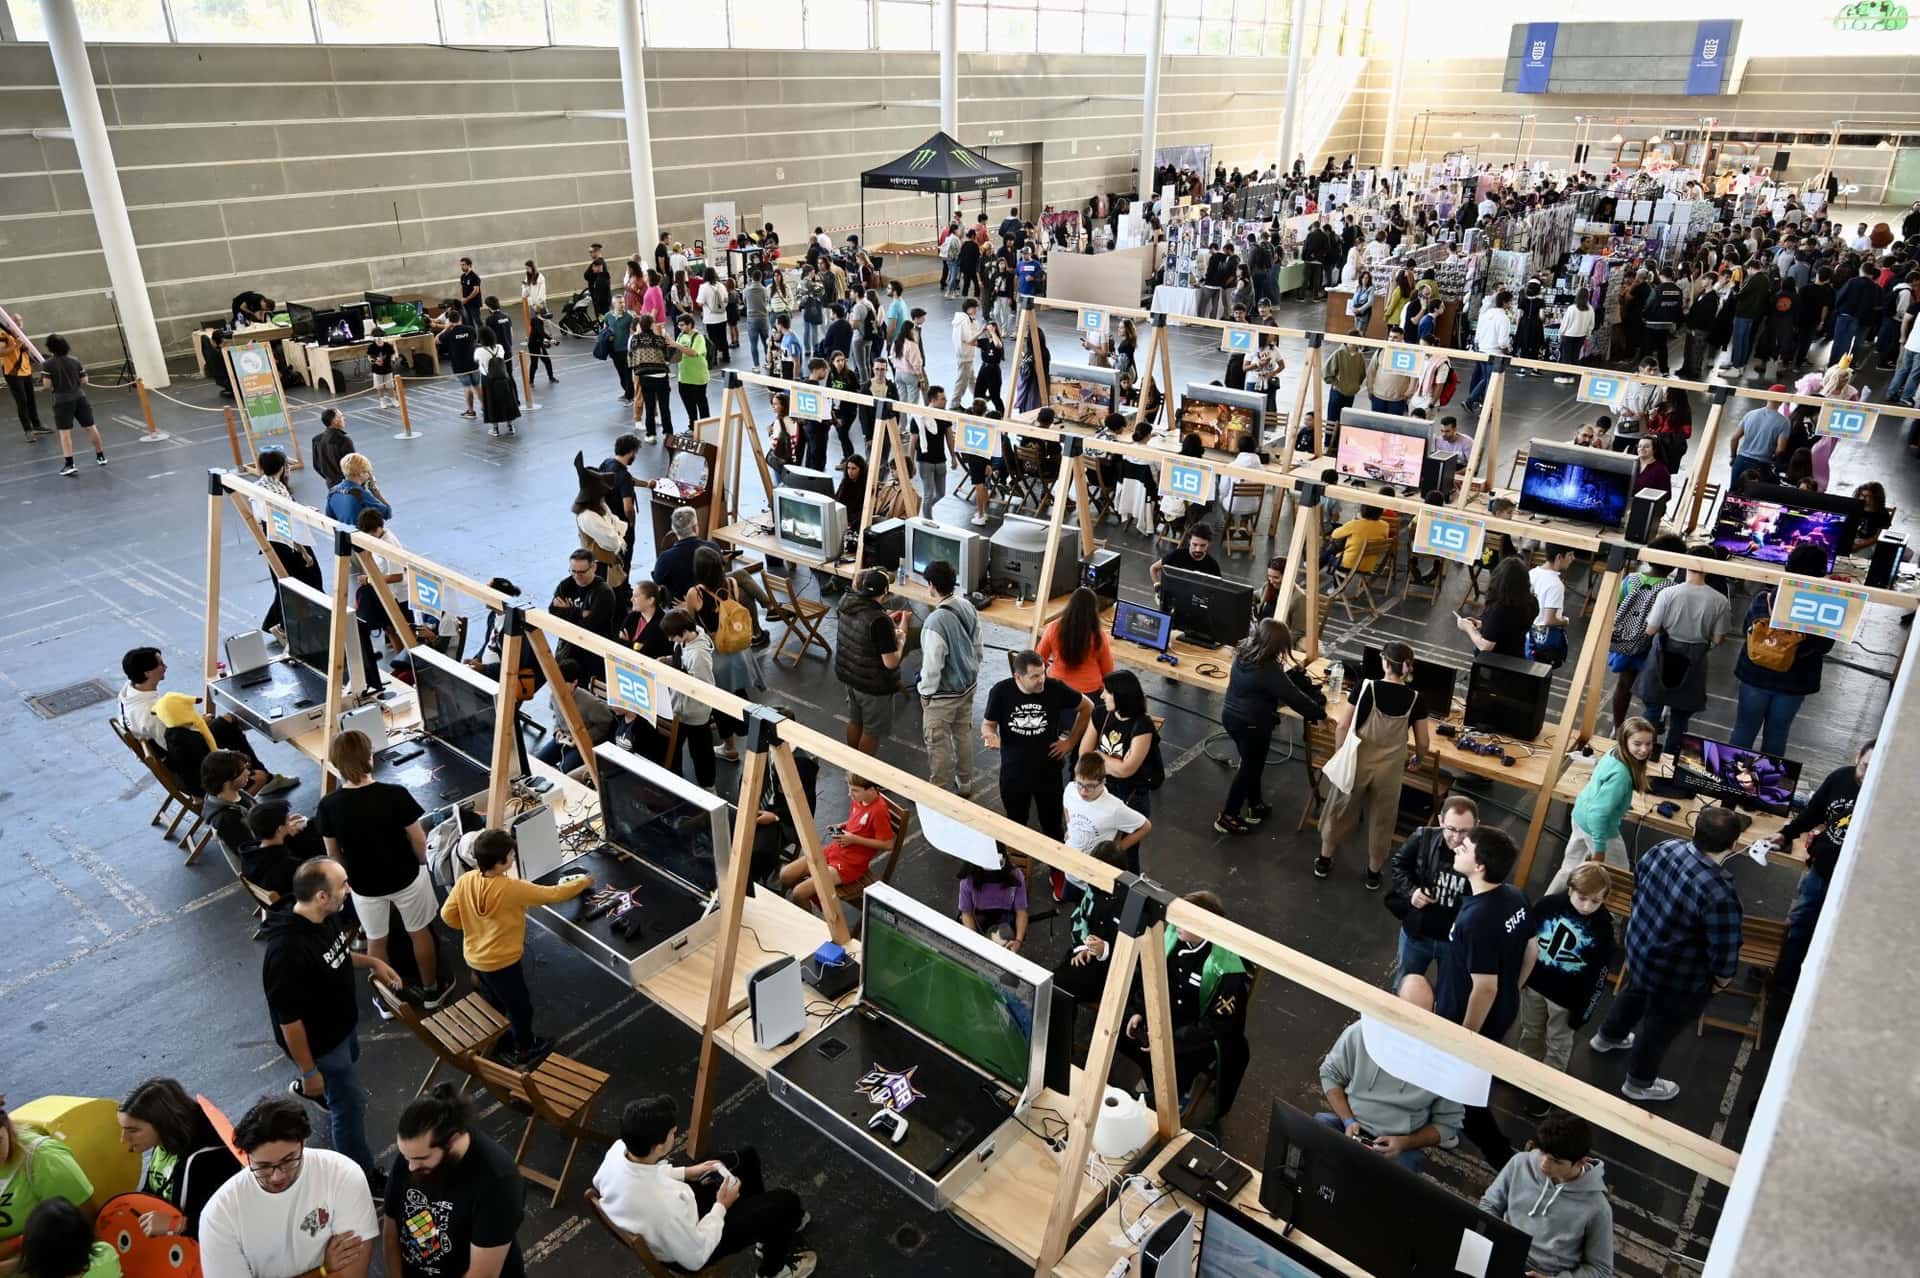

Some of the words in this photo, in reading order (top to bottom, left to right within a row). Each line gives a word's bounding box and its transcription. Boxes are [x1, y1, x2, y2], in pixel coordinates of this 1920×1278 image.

[1087, 313, 1097, 327] 6
[1234, 333, 1247, 346] 7
[1397, 354, 1410, 368] 8
[1594, 380, 1612, 397] 9
[799, 395, 816, 413] 16
[1829, 411, 1864, 431] 10
[967, 429, 987, 447] 17
[1172, 470, 1199, 492] 18
[1431, 525, 1465, 550] 19
[417, 582, 439, 606] 27
[1790, 597, 1845, 626] 20
[617, 673, 650, 707] 28
[1504, 907, 1526, 933] STAFF
[860, 1072, 913, 1109] STAR
[870, 1086, 893, 1103] UP
